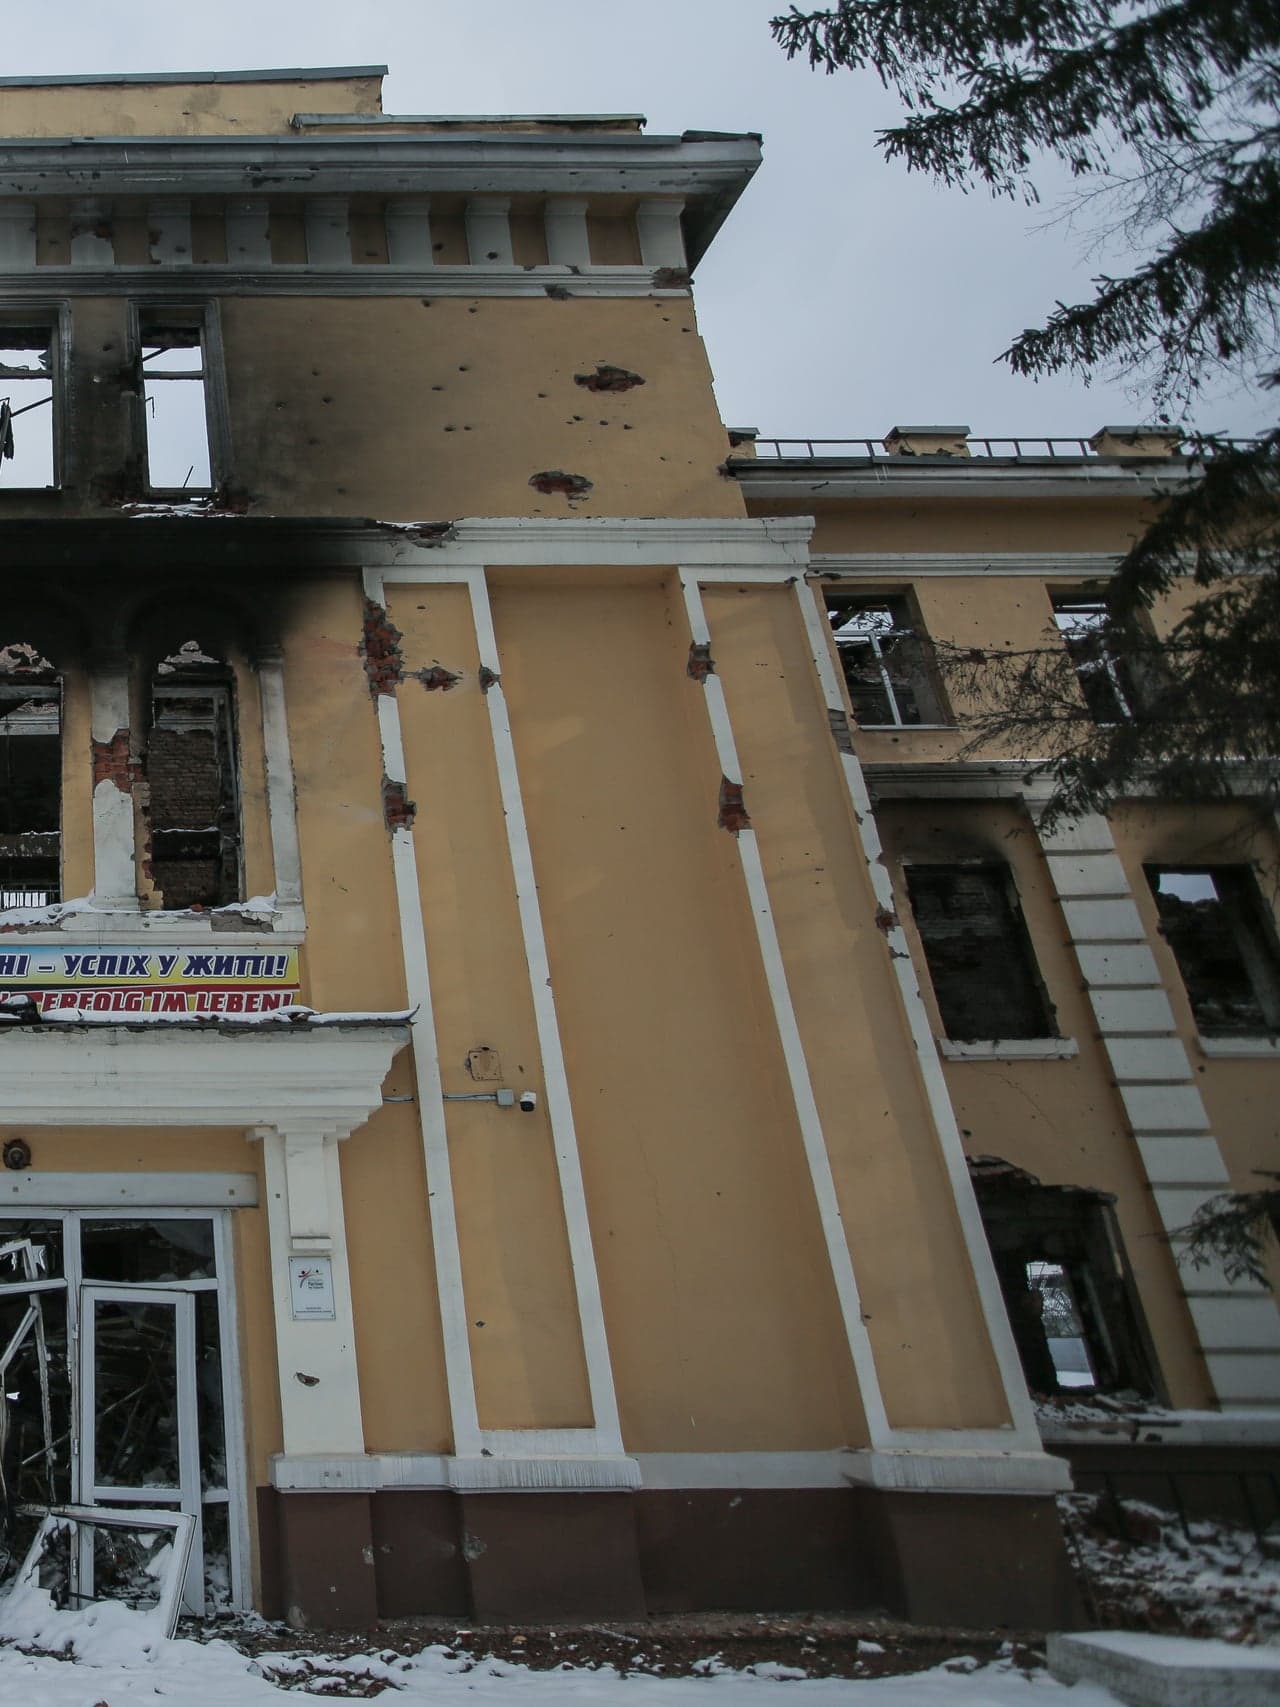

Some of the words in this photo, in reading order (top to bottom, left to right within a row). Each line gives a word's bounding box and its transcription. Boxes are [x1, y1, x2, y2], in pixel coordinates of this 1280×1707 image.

[63, 953, 152, 978] УСПІХ
[157, 953, 179, 978] У
[41, 992, 145, 1013] ERFOLG
[151, 992, 190, 1013] IM
[194, 992, 295, 1013] LEBEN!
